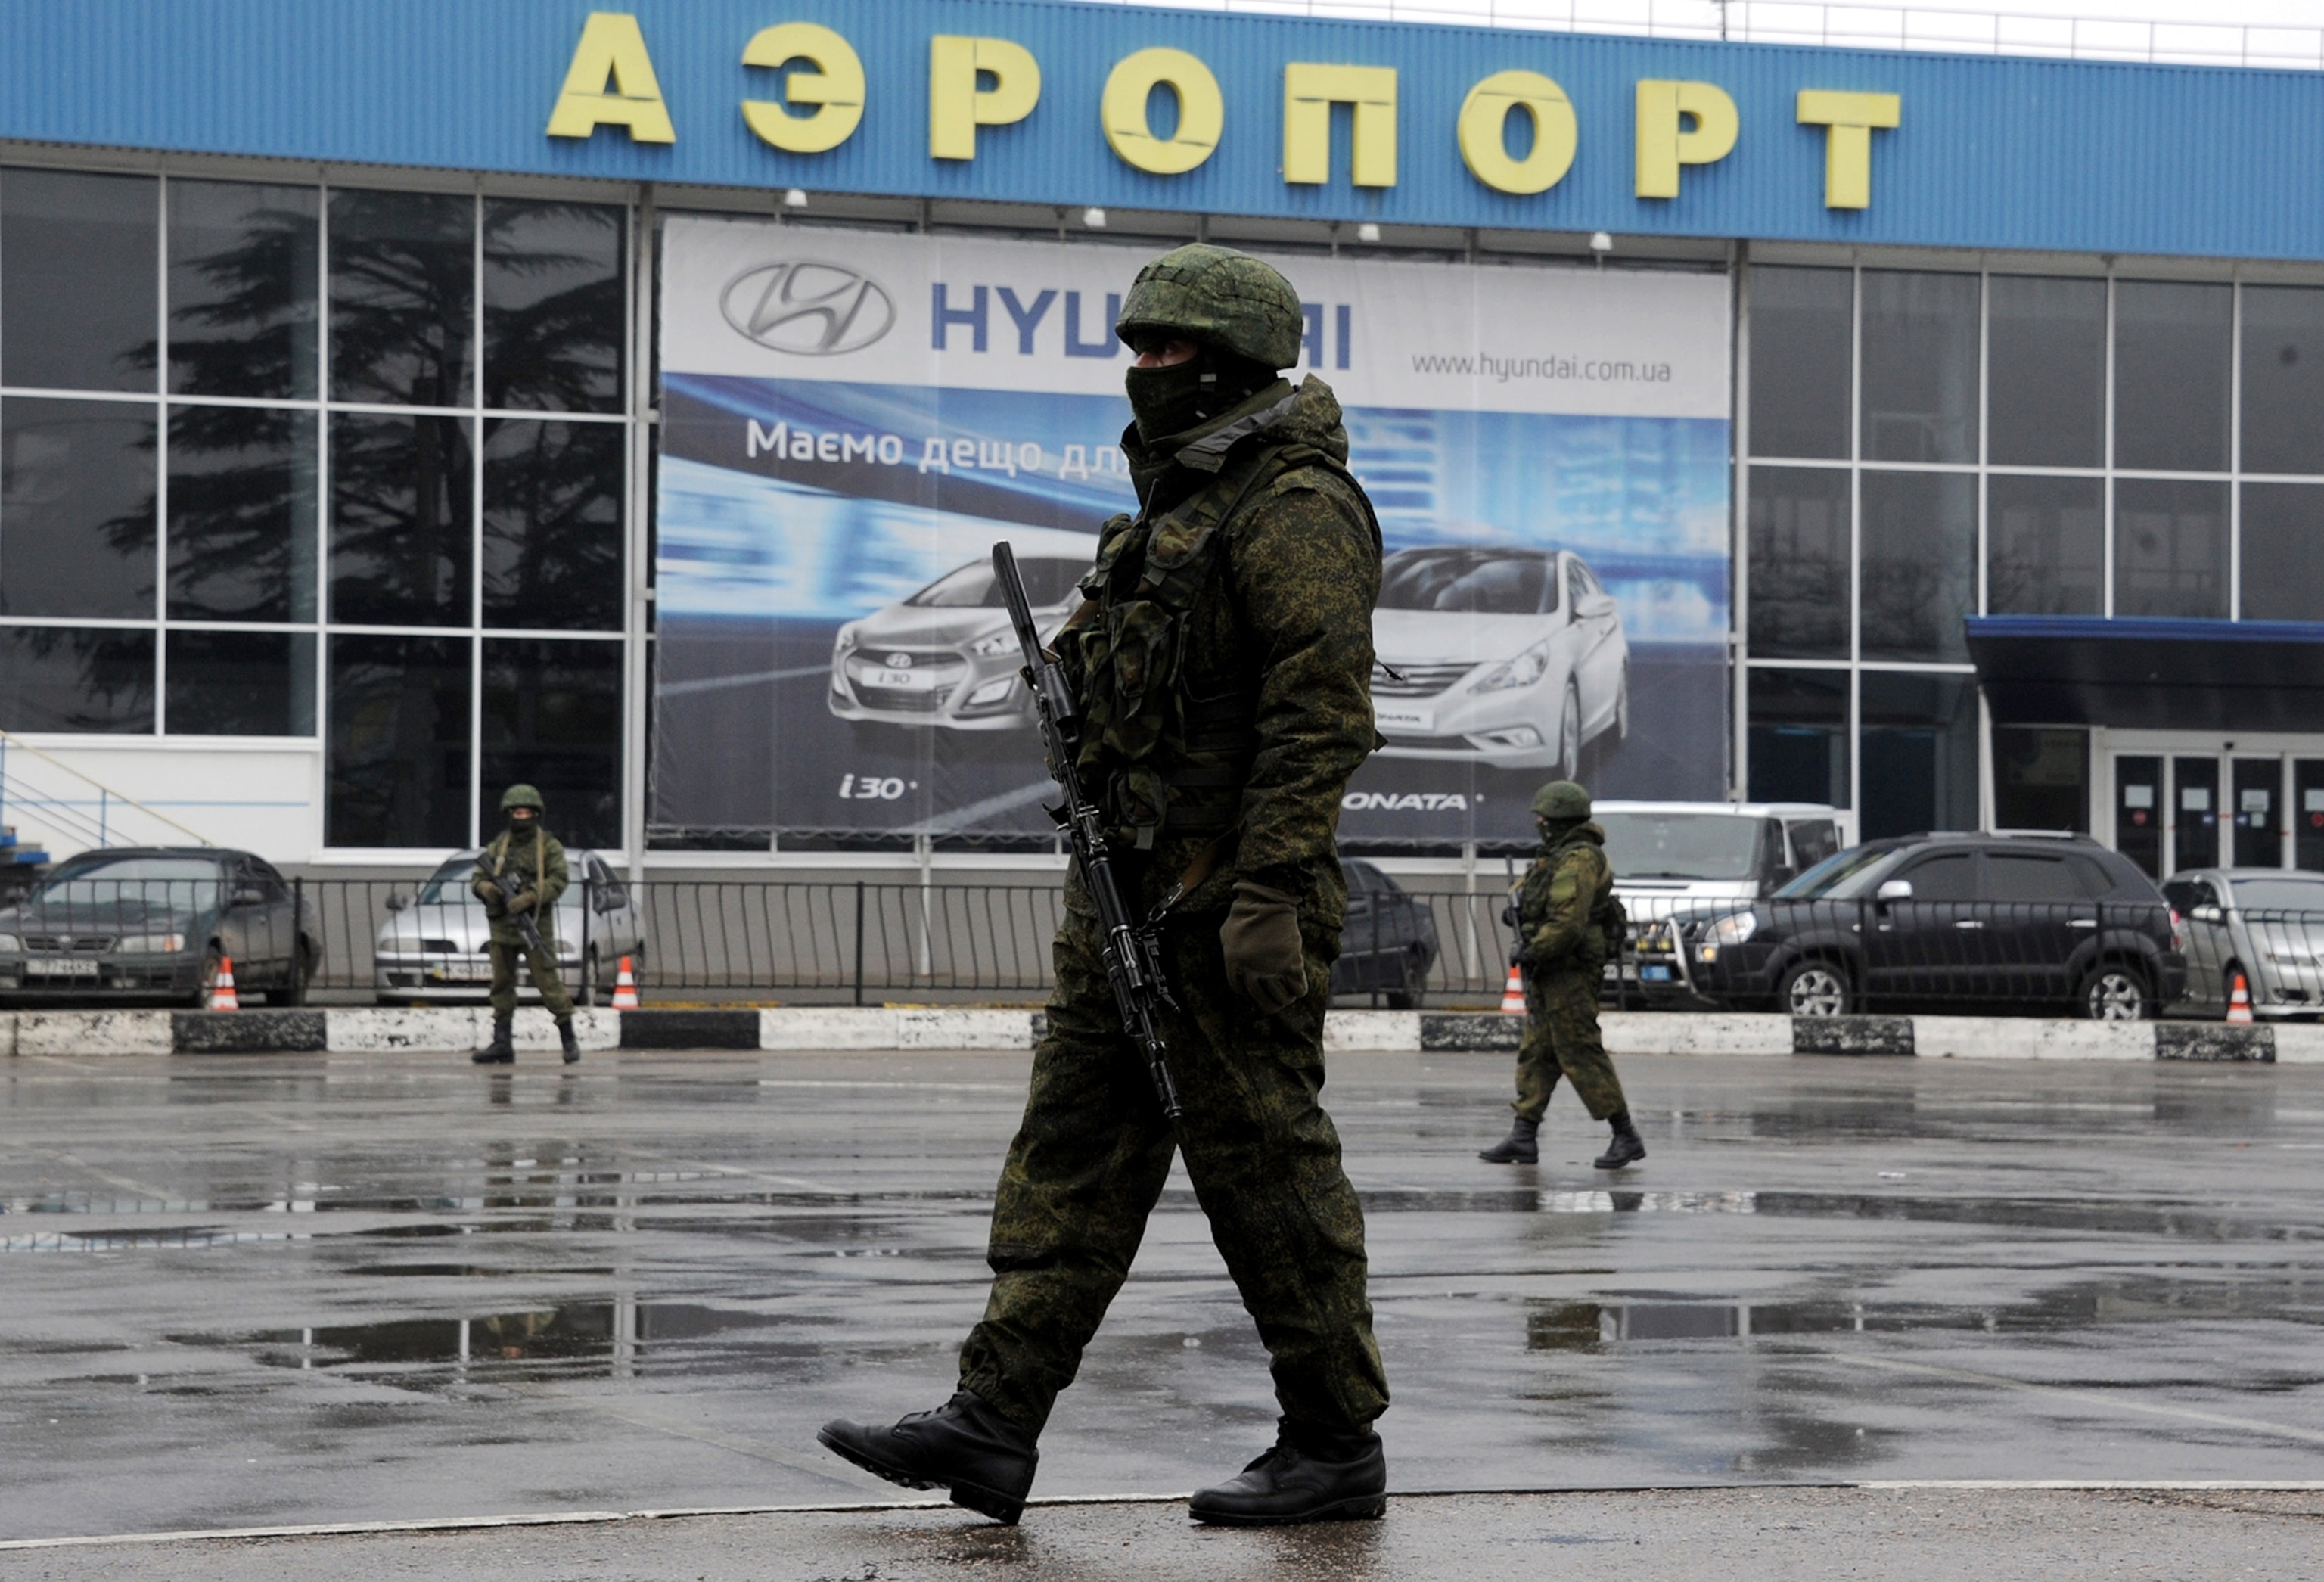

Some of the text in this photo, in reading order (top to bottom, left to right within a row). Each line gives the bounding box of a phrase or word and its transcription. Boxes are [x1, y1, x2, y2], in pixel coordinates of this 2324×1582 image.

[546, 11, 1901, 210] АЭРОПОРТ
[931, 282, 1350, 371] HYUI
[1412, 352, 1672, 383] www.hyundai.com.ua
[746, 418, 1129, 480] Маємо дещо дл
[1341, 792, 1484, 811] ONATA
